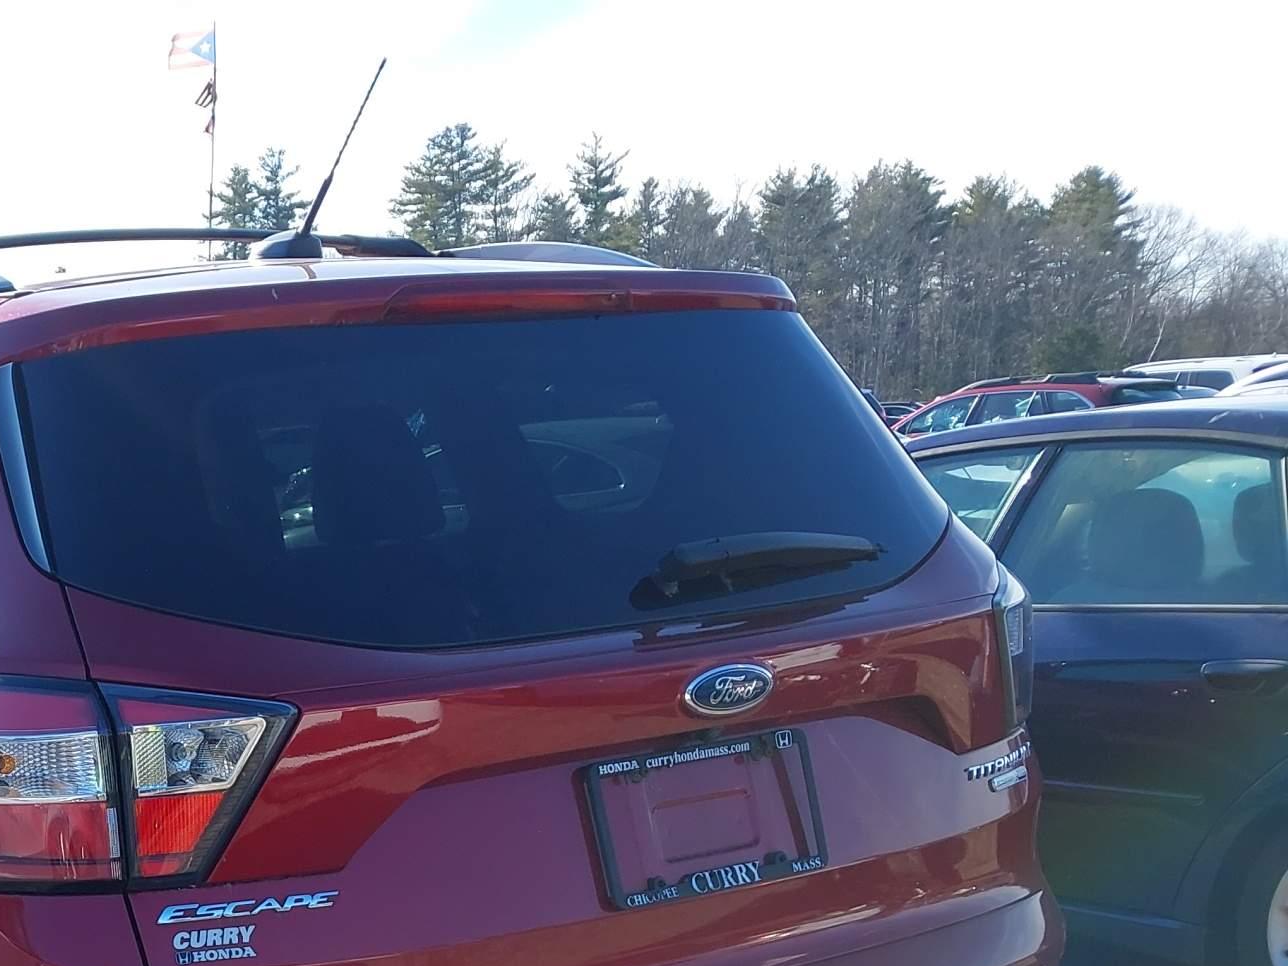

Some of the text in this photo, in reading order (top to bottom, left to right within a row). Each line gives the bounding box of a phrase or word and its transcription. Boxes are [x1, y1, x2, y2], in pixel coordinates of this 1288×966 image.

[710, 675, 760, 705] Ford
[599, 741, 750, 776] HONDA curryhondamass.com
[691, 861, 762, 894] CURRY
[792, 856, 825, 873] MASS.
[157, 891, 339, 924] ESCAPE
[173, 925, 256, 950] CURRY
[193, 947, 257, 963] HONDA
